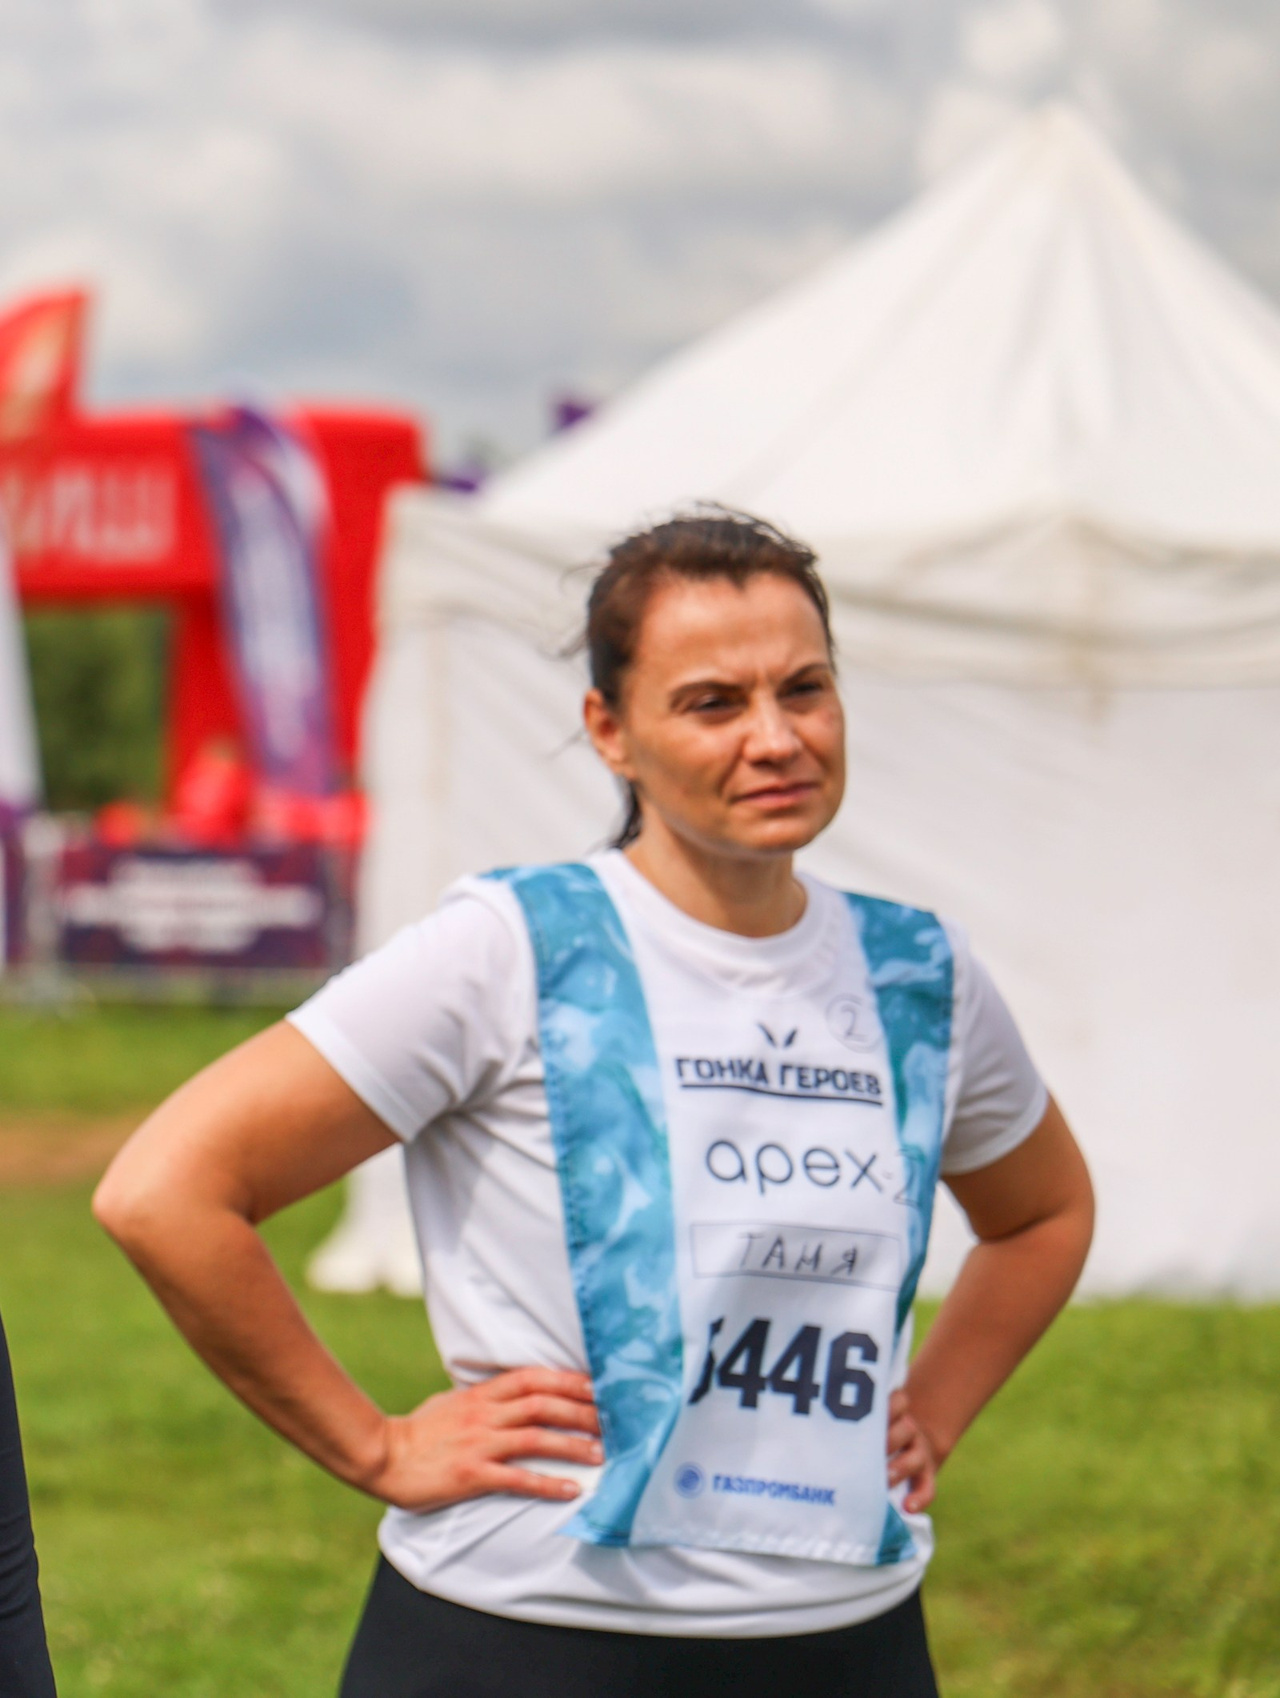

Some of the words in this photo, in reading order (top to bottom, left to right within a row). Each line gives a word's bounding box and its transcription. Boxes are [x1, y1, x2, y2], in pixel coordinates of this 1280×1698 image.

[675, 1057, 768, 1085] ГОНКА
[779, 1064, 883, 1095] ГЕРОЕВ
[706, 1139, 884, 1196] apex
[712, 1473, 836, 1506] ГАЗПРОМБАНК
